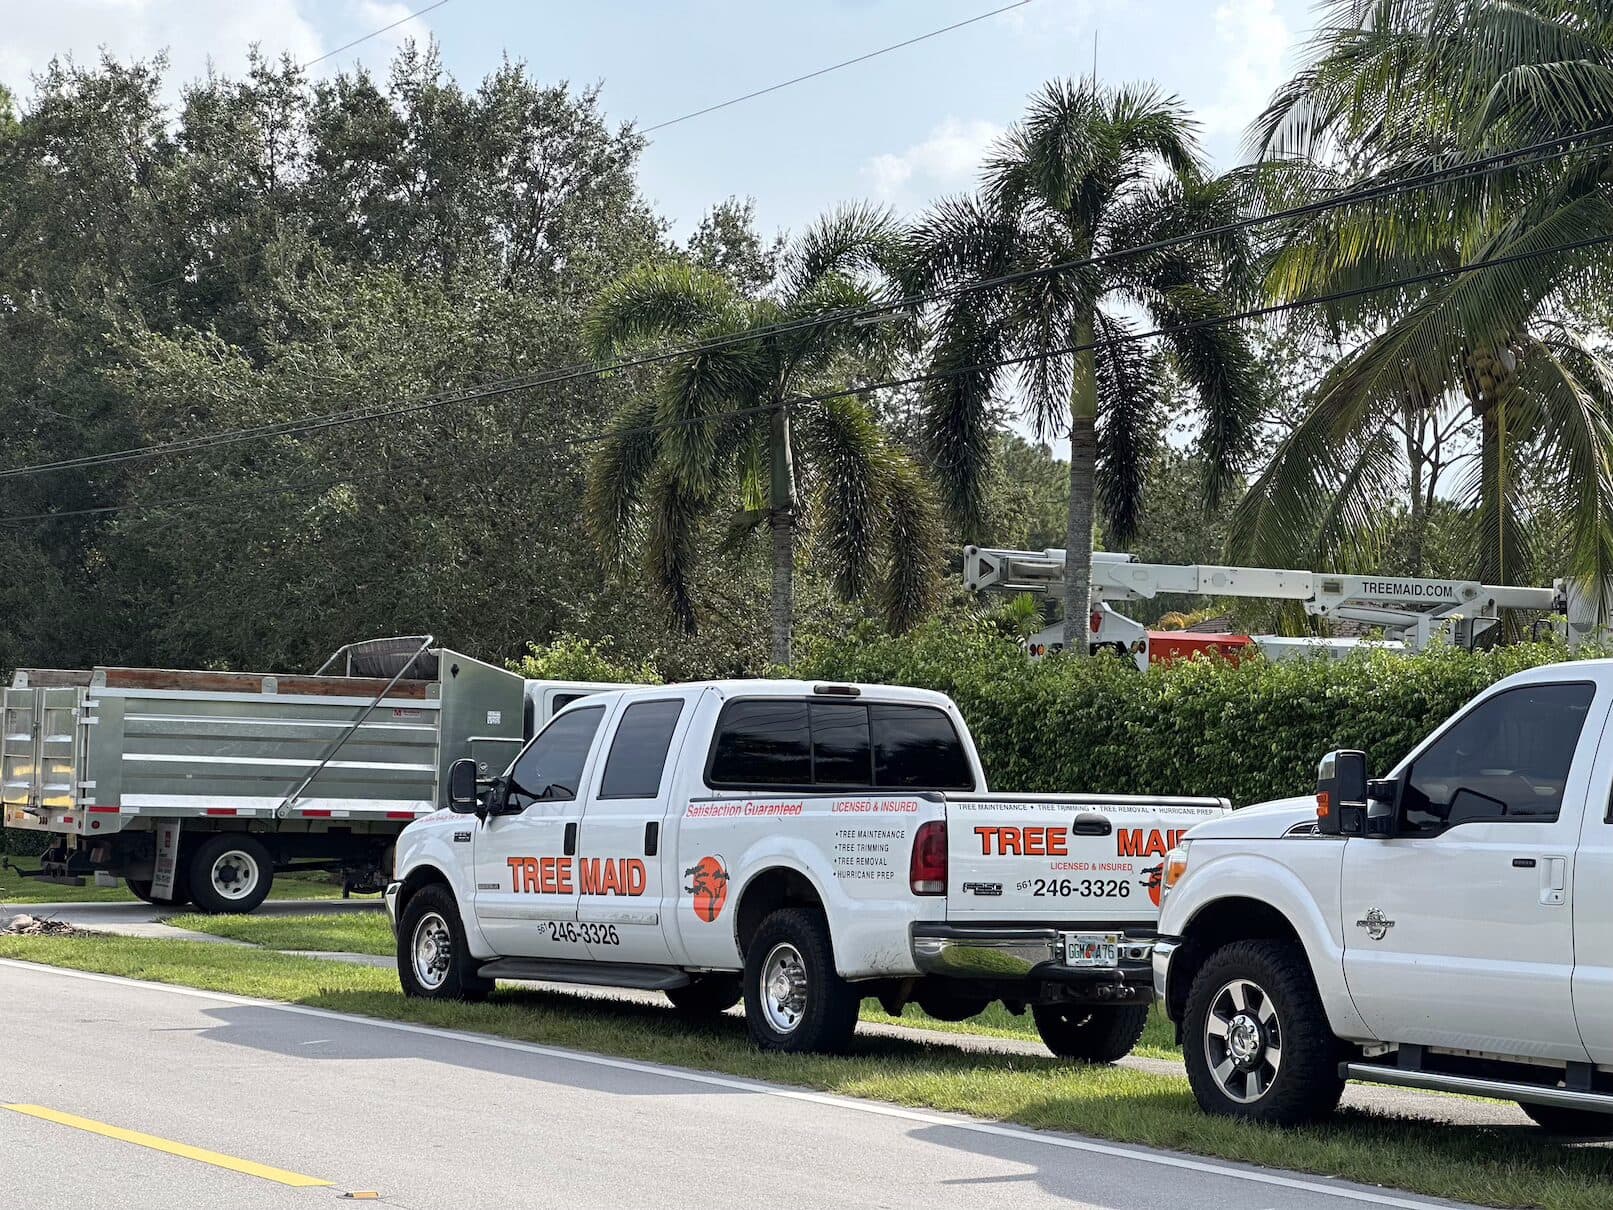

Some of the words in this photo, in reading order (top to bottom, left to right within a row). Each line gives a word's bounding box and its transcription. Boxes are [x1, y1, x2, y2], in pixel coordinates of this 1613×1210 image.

[1362, 582, 1453, 597] TREEMAID.COM
[686, 803, 742, 818] Satisfaction
[744, 801, 803, 816] Guaranteed
[832, 801, 871, 812] LICENSED
[872, 801, 879, 812] &
[880, 801, 918, 812] INSURED
[959, 803, 977, 811] TREE
[1057, 804, 1090, 812] TRIMMING
[1100, 805, 1118, 813] TREE
[1118, 806, 1150, 814] REMOVAL
[1159, 807, 1196, 815] HURRICANE
[1196, 808, 1213, 816] PREP
[839, 830, 856, 839] TREE
[857, 830, 905, 839] MAINTENANCE
[838, 843, 855, 852] TREE
[857, 843, 889, 852] TRIMMING
[974, 826, 1068, 856] TREE
[1117, 828, 1190, 857] MAI
[838, 857, 854, 866] TREE
[856, 857, 887, 866] REMOVAL
[1050, 862, 1089, 871] LICENSED
[1091, 863, 1097, 871] &
[1098, 863, 1133, 871] INSURED
[507, 856, 573, 895] TREE
[579, 857, 647, 897] MAID
[837, 870, 875, 879] HURRICANE
[876, 871, 895, 880] PREP
[1016, 879, 1032, 891] 561
[1033, 878, 1130, 898] 246-3326
[537, 922, 548, 935] 561
[548, 921, 620, 945] 246-3326
